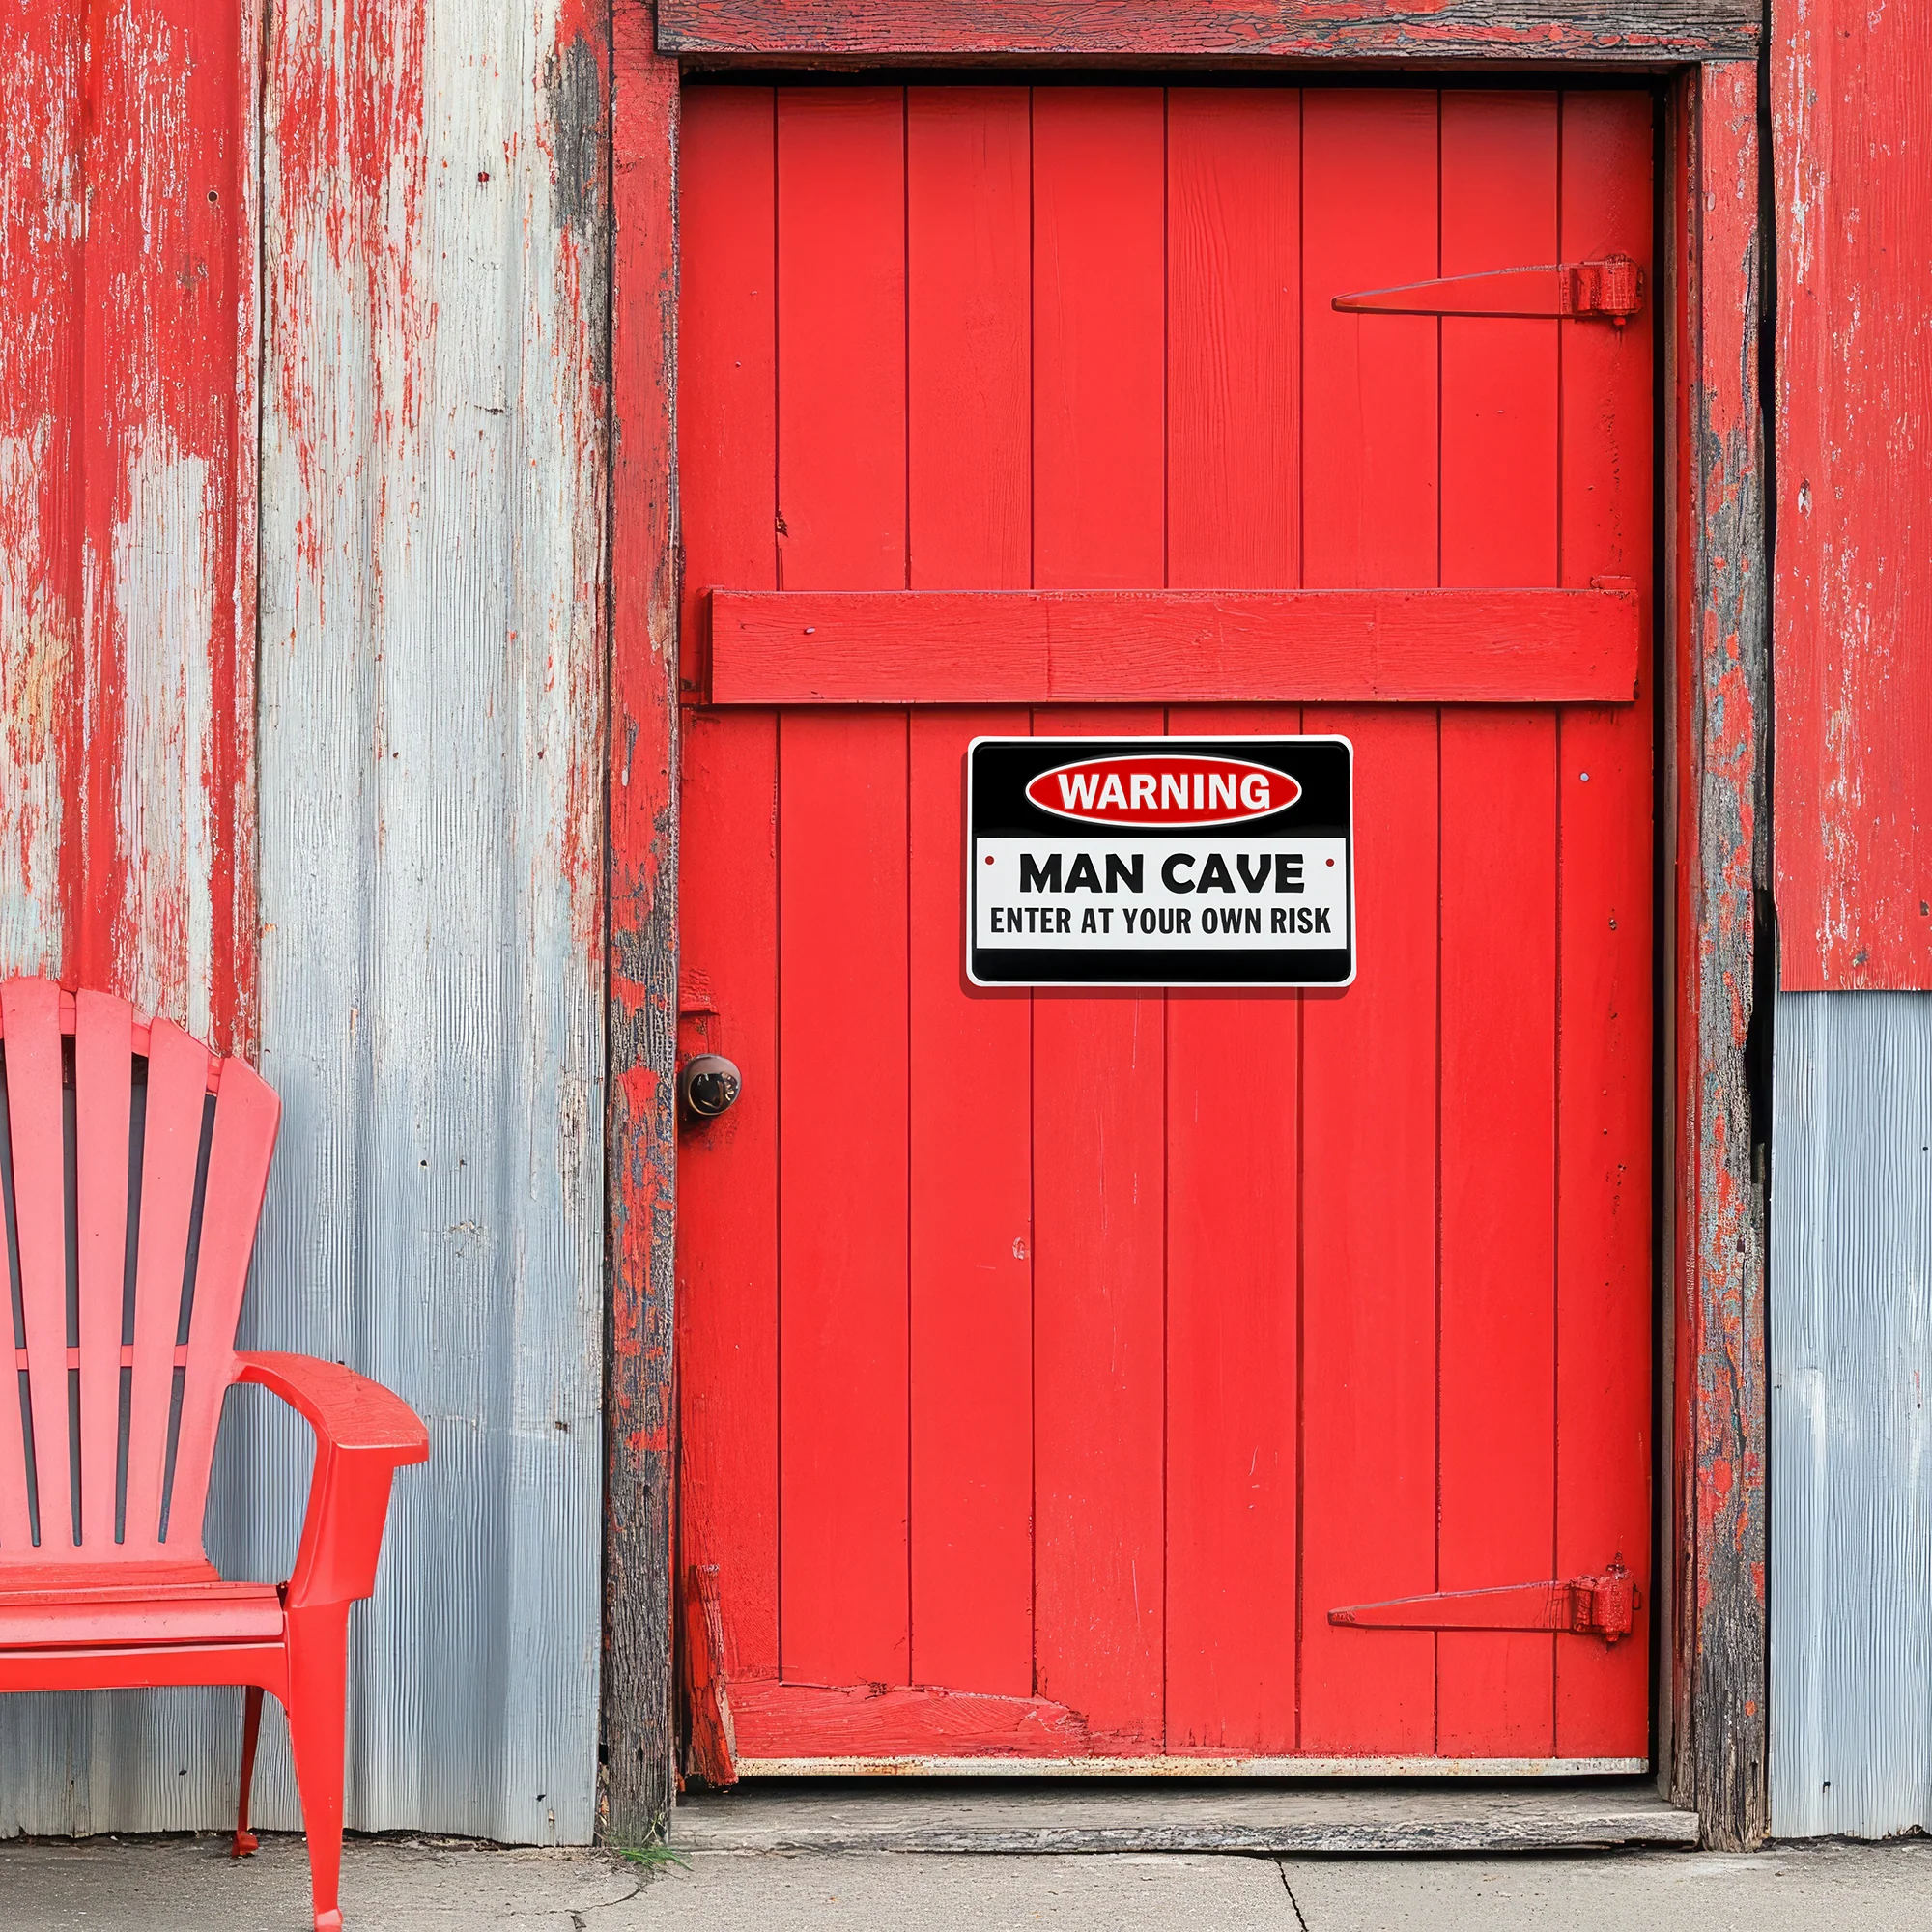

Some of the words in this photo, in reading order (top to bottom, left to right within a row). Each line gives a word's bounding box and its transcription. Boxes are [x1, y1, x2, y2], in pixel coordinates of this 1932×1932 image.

[1058, 774, 1270, 810] WARNING
[1020, 854, 1143, 893] MAN
[1161, 854, 1304, 894] CAVE
[991, 908, 1070, 933] ENTER
[1082, 908, 1113, 933] AT
[1122, 909, 1191, 934] YOUR
[1202, 908, 1261, 933] OWN
[1271, 908, 1330, 933] RISK
